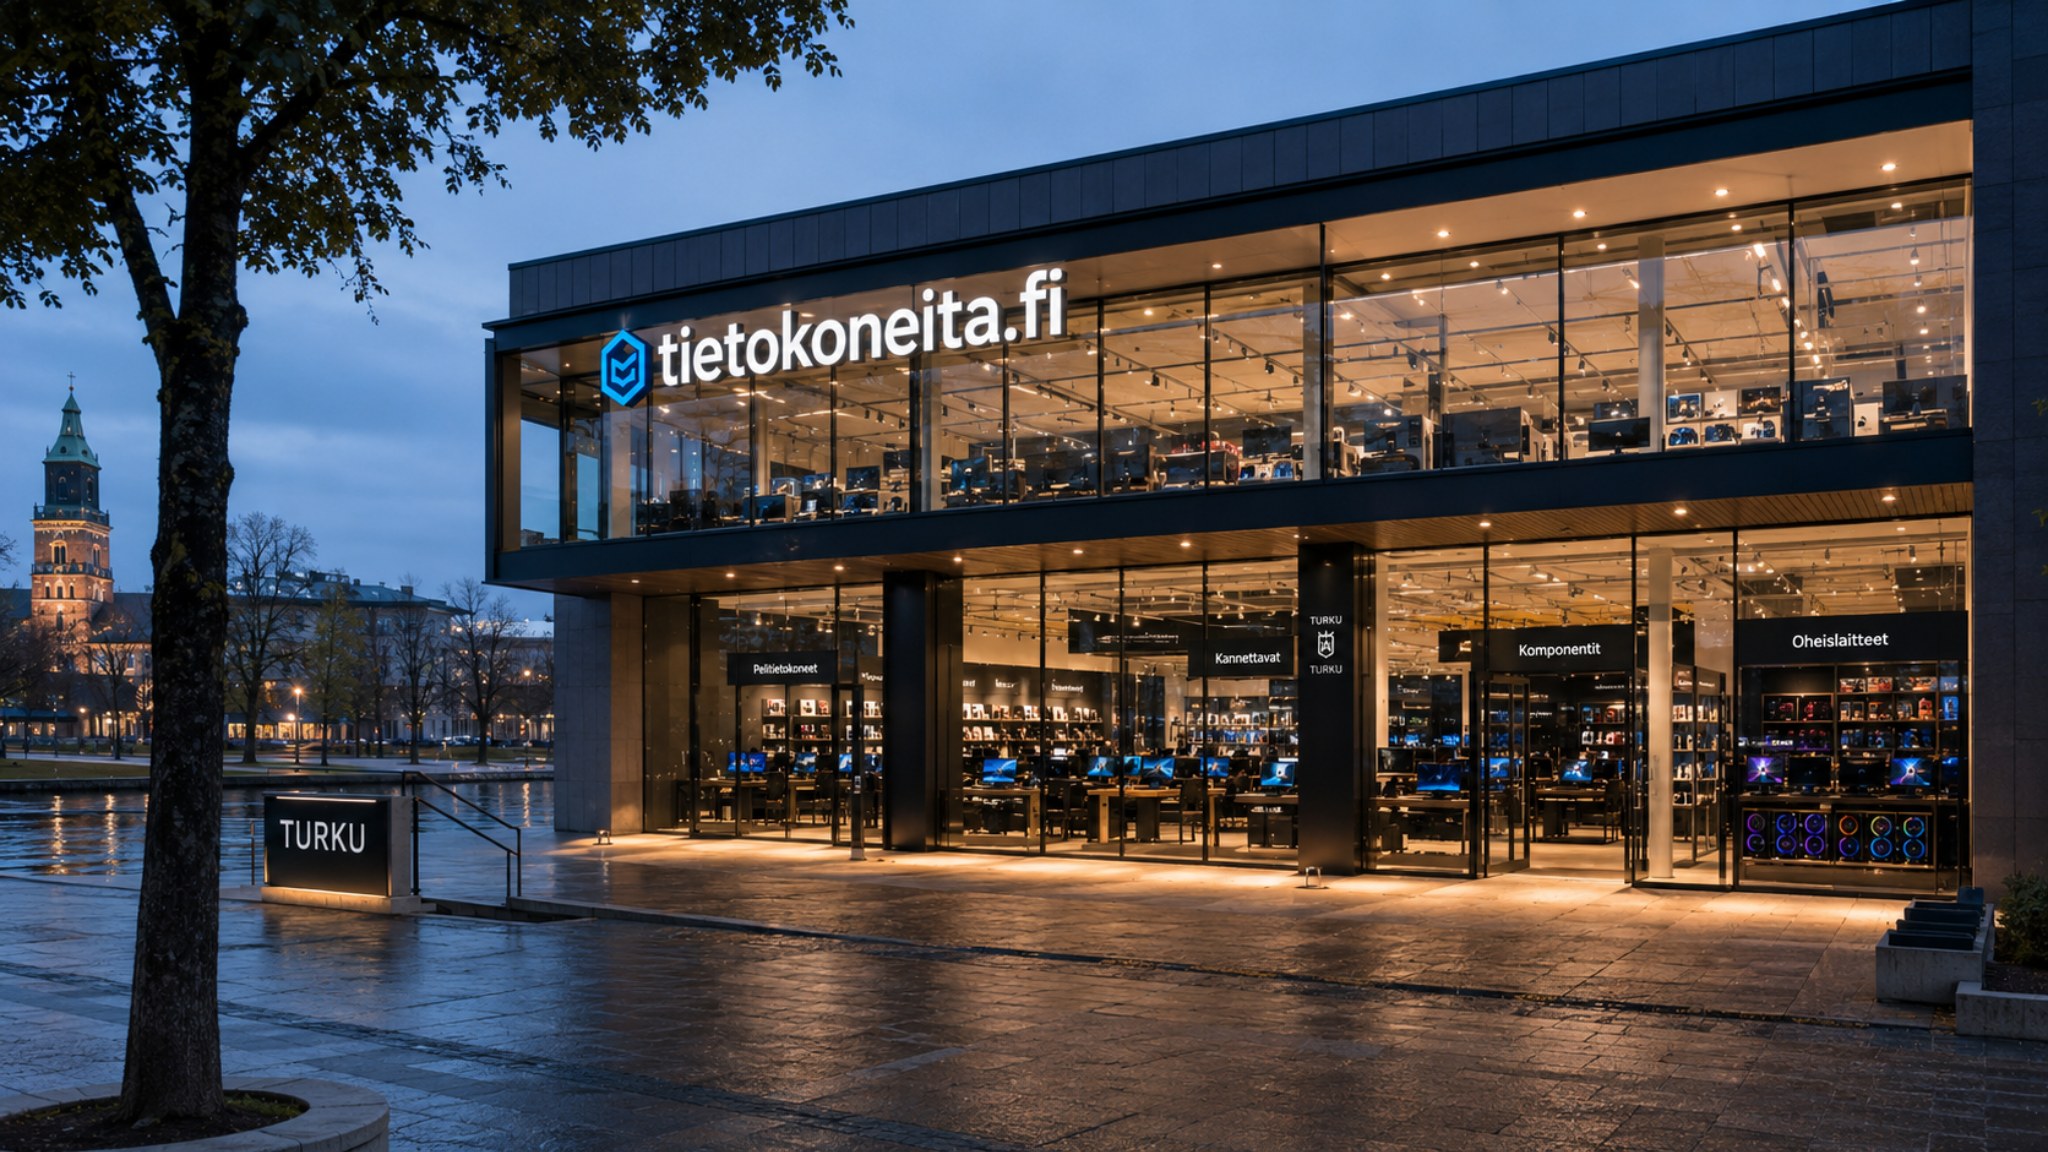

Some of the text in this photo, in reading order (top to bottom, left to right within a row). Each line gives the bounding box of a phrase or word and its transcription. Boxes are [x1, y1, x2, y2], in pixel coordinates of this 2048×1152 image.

[658, 267, 1064, 387] tietokoneita.fi
[1310, 615, 1343, 626] TURKU
[1792, 632, 1889, 649] Oheislaitteet
[1215, 652, 1281, 665] Kannettavat
[1518, 642, 1602, 659] Komponentit
[1310, 664, 1343, 675] TURKU
[279, 819, 366, 854] TURKU
